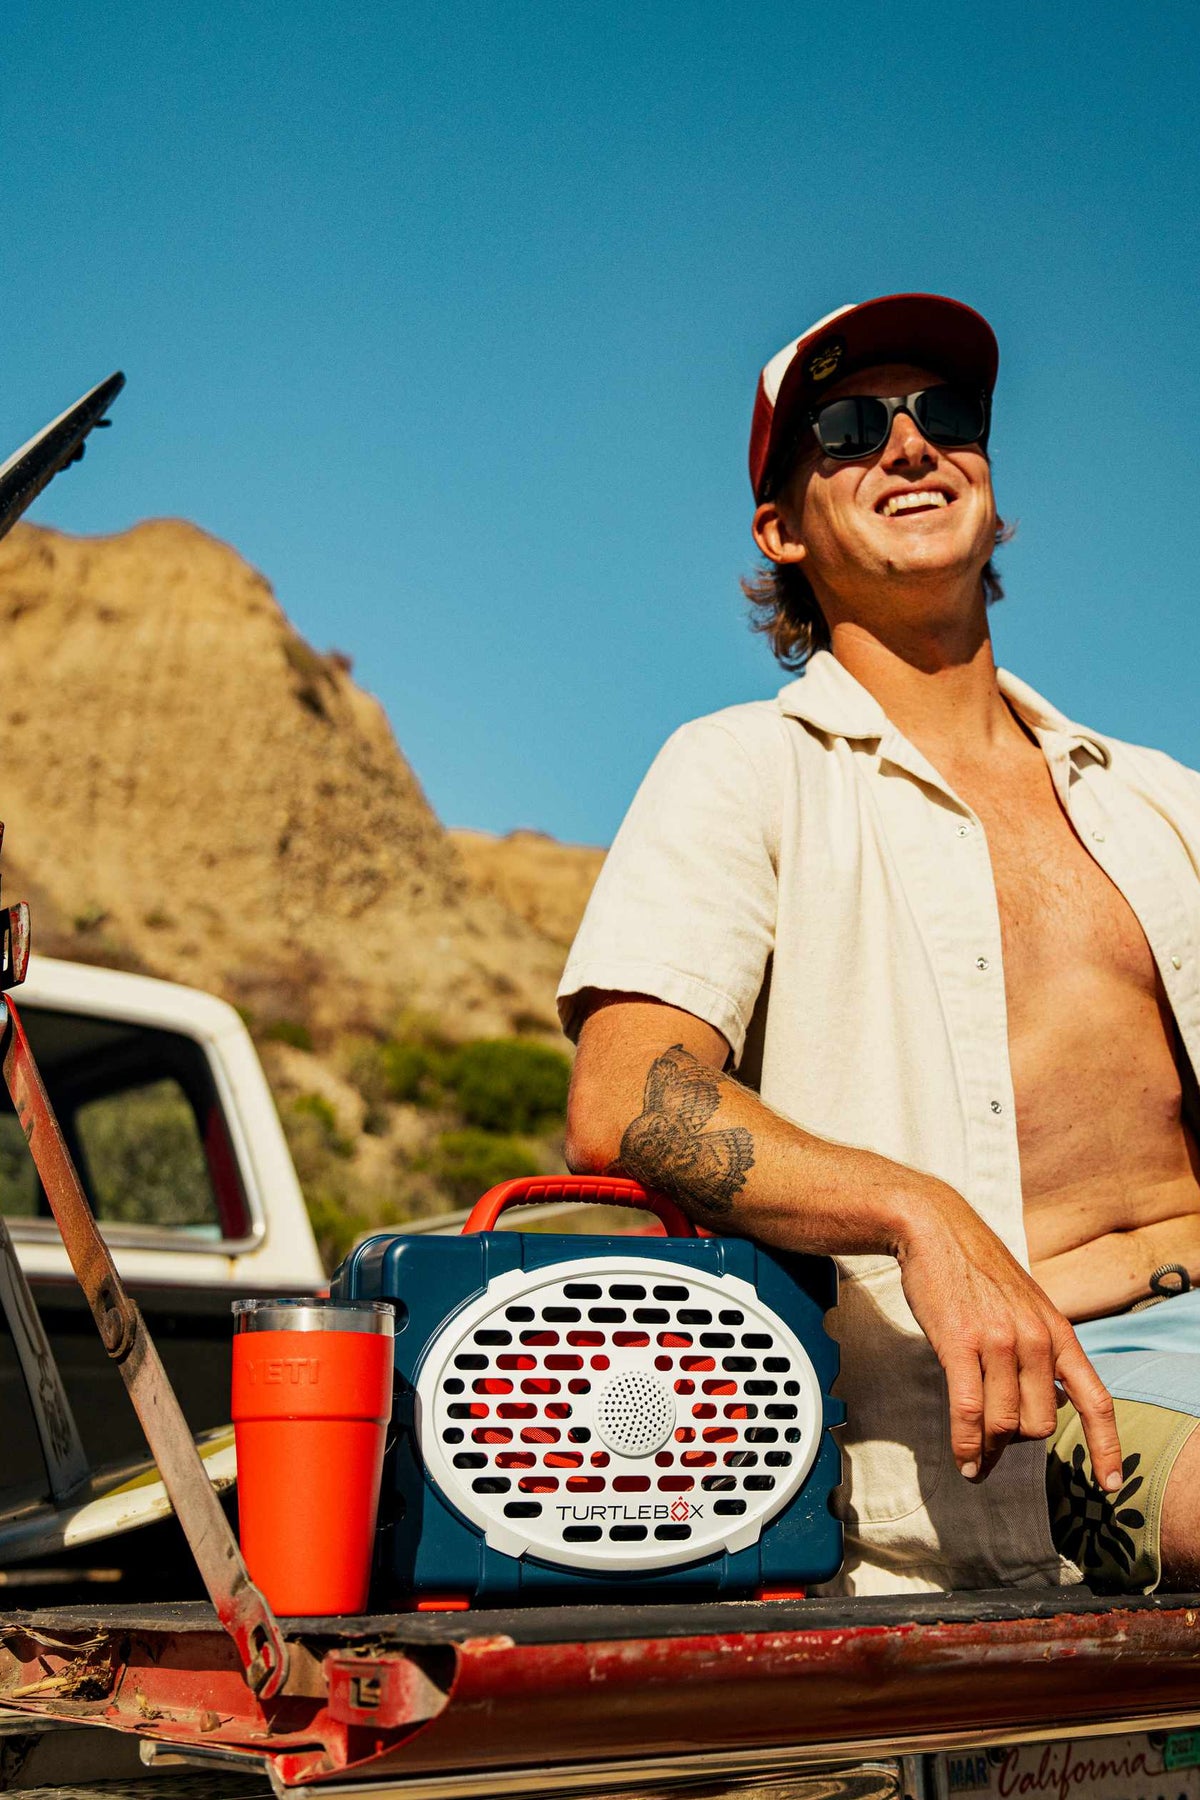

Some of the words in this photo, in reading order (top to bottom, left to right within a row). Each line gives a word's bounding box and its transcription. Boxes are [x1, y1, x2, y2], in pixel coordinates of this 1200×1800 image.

[247, 1358, 320, 1385] YETI
[556, 1496, 704, 1521] TURTLEBOX
[951, 1757, 988, 1785] MAR
[999, 1740, 1162, 1800] California
